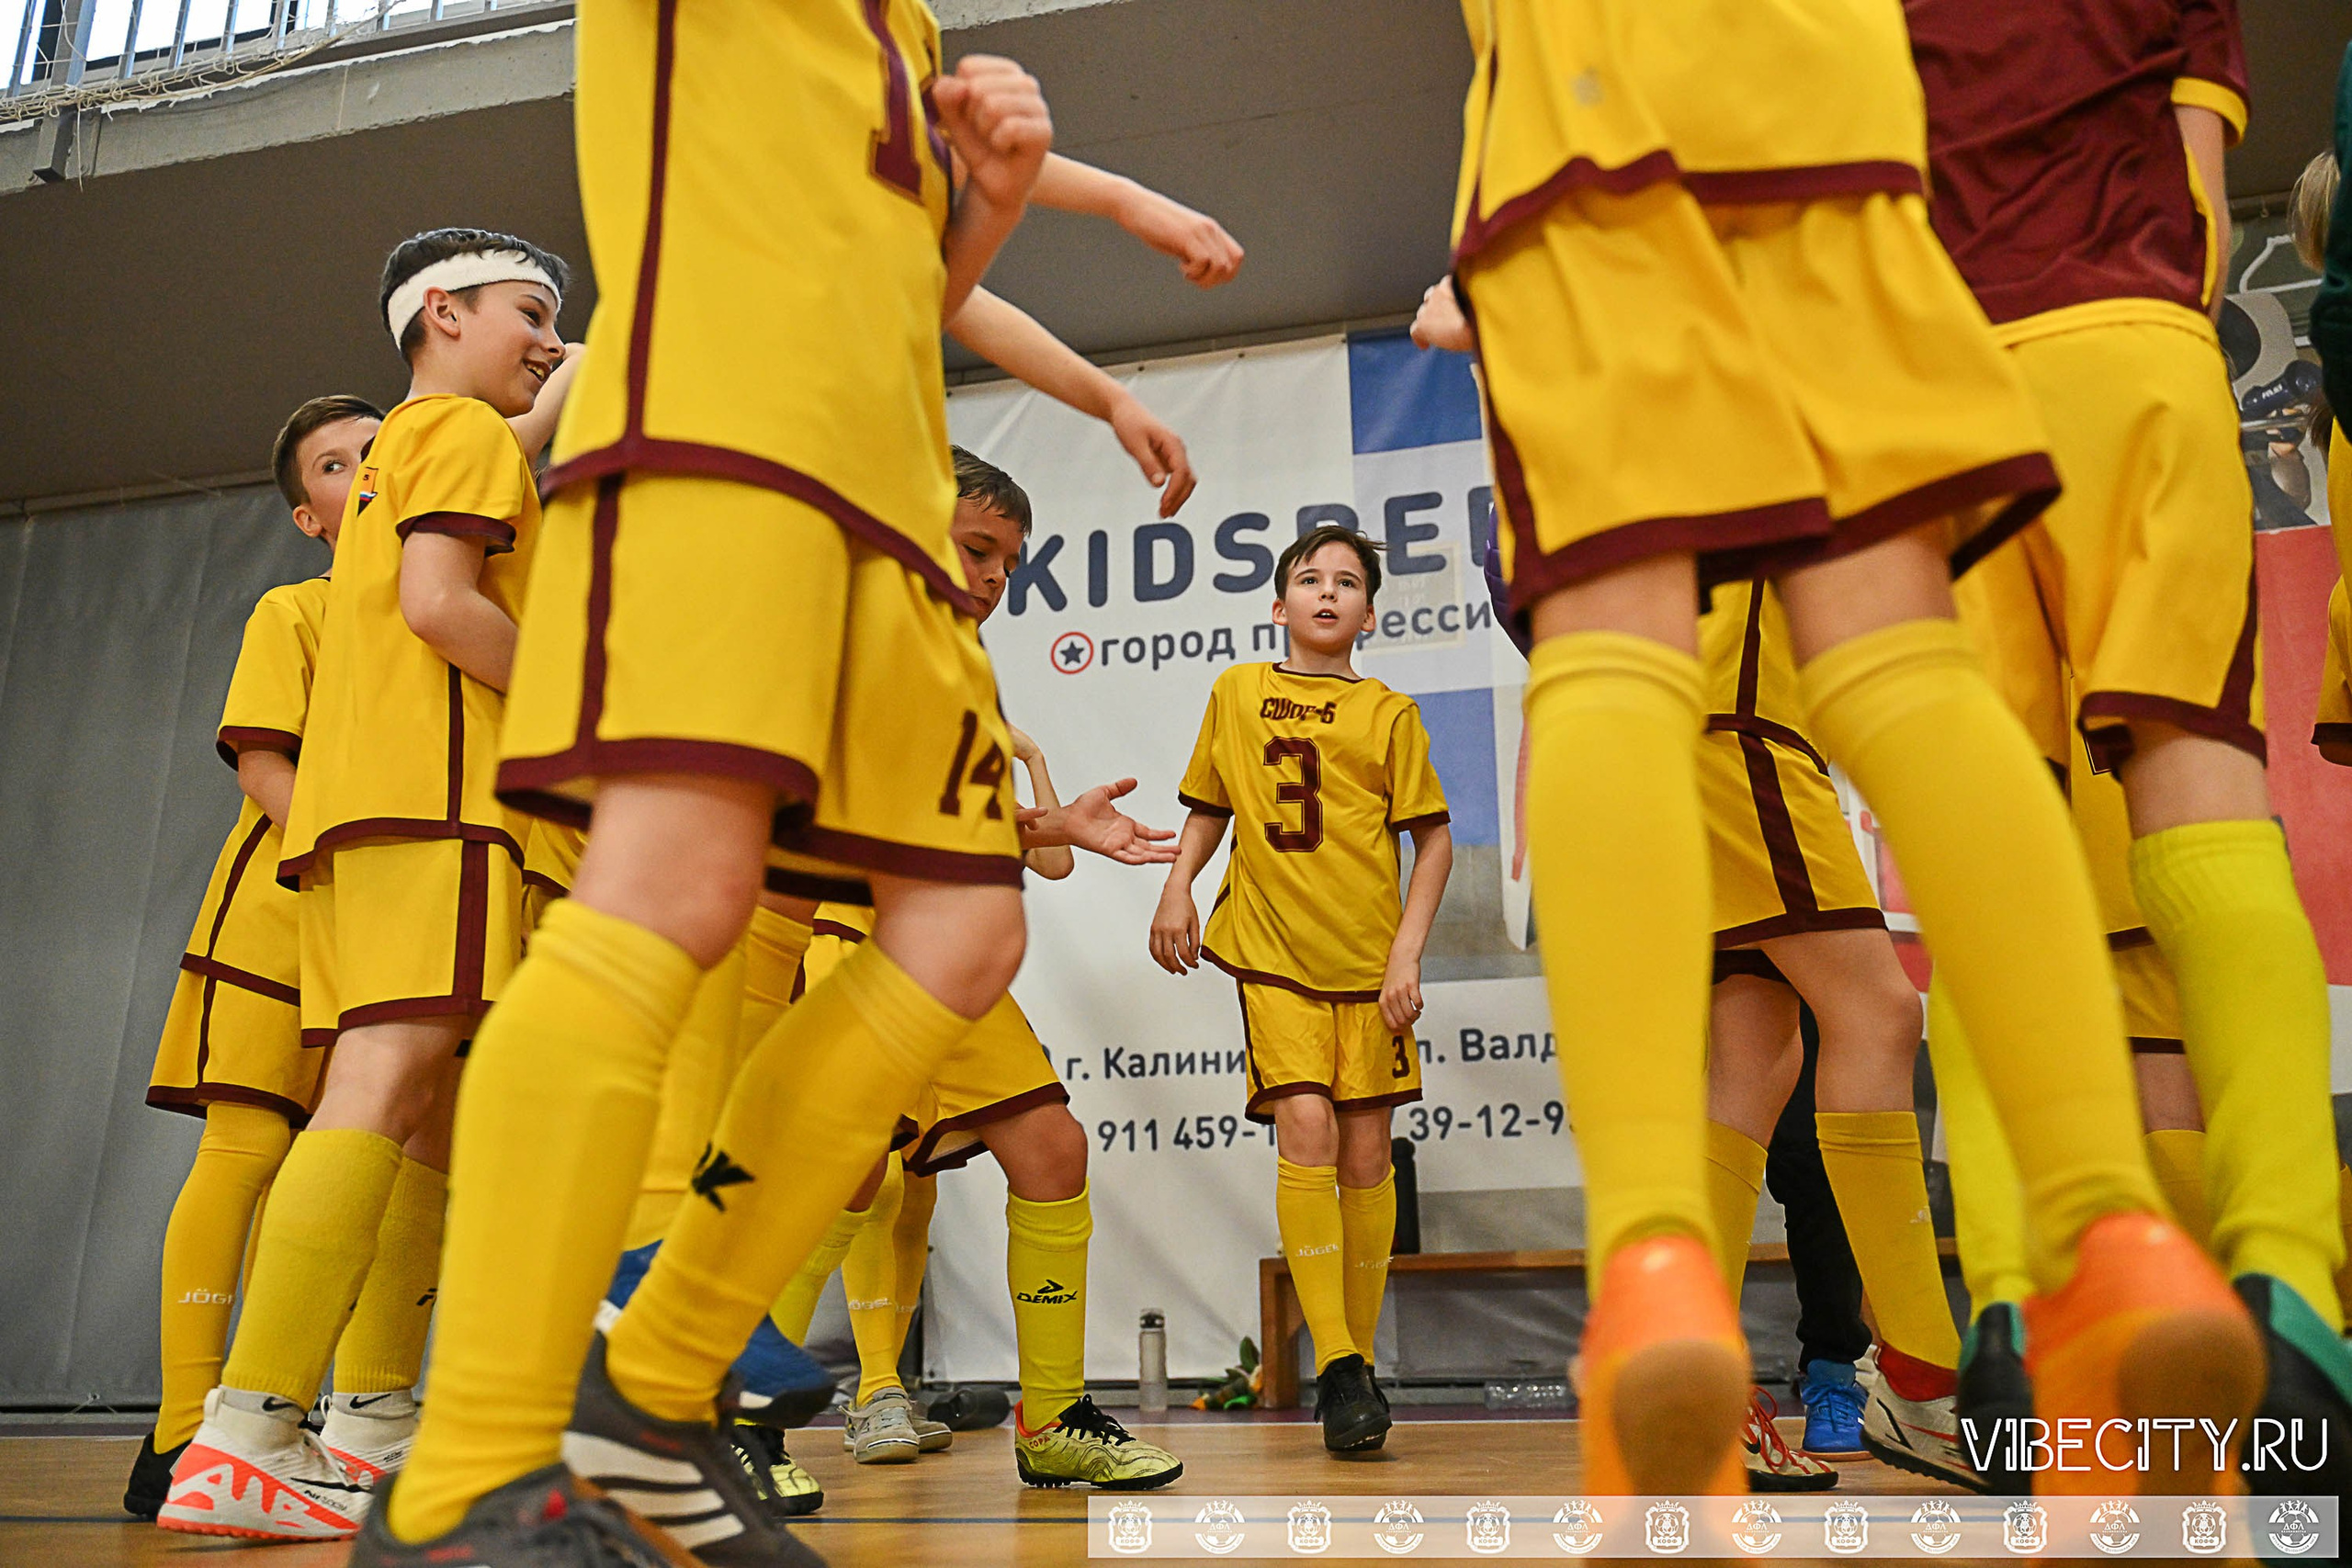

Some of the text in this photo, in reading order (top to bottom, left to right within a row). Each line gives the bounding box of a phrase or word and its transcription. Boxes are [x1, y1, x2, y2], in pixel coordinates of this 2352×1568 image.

[1102, 601, 1491, 671] город песси
[939, 709, 1005, 820] 14
[1263, 736, 1324, 852] 3
[1067, 1058, 1090, 1080] г.
[1392, 1035, 1410, 1078] 3
[1098, 1119, 1158, 1152] 911
[1408, 1100, 1573, 1141] 39-12-9
[1016, 1291, 1078, 1304] DEMIX
